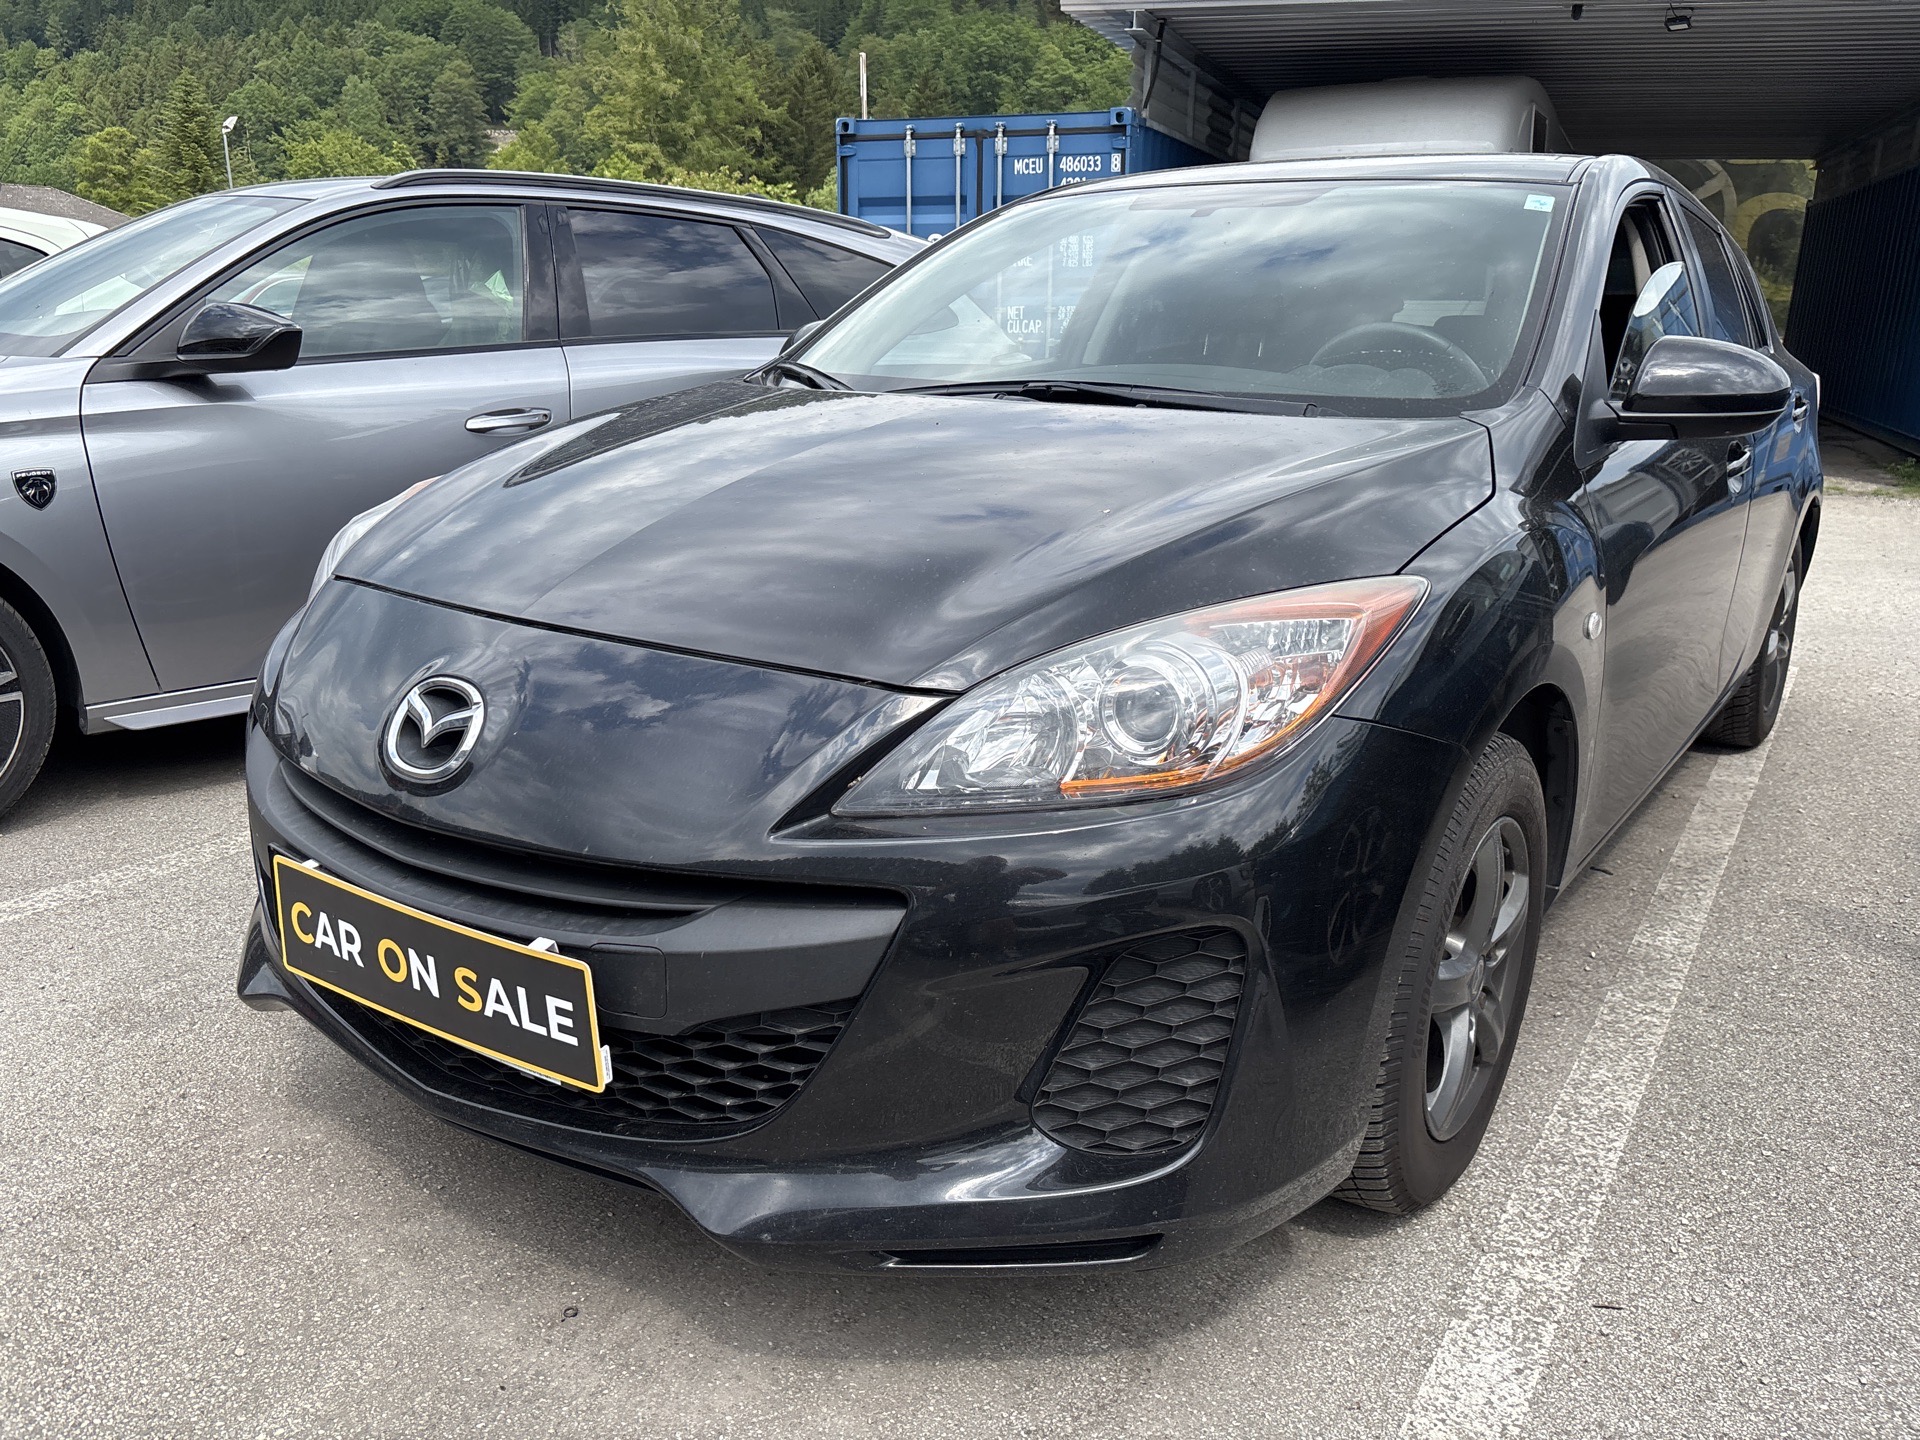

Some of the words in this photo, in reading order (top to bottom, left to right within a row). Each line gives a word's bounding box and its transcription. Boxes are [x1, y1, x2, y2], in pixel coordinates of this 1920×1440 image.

[1014, 157, 1043, 174] MCEU
[1060, 155, 1102, 172] 486033
[1112, 154, 1120, 171] 8
[1007, 305, 1025, 320] NET
[291, 901, 364, 968] CAR
[377, 938, 440, 998] ON
[453, 966, 579, 1046] SALE
